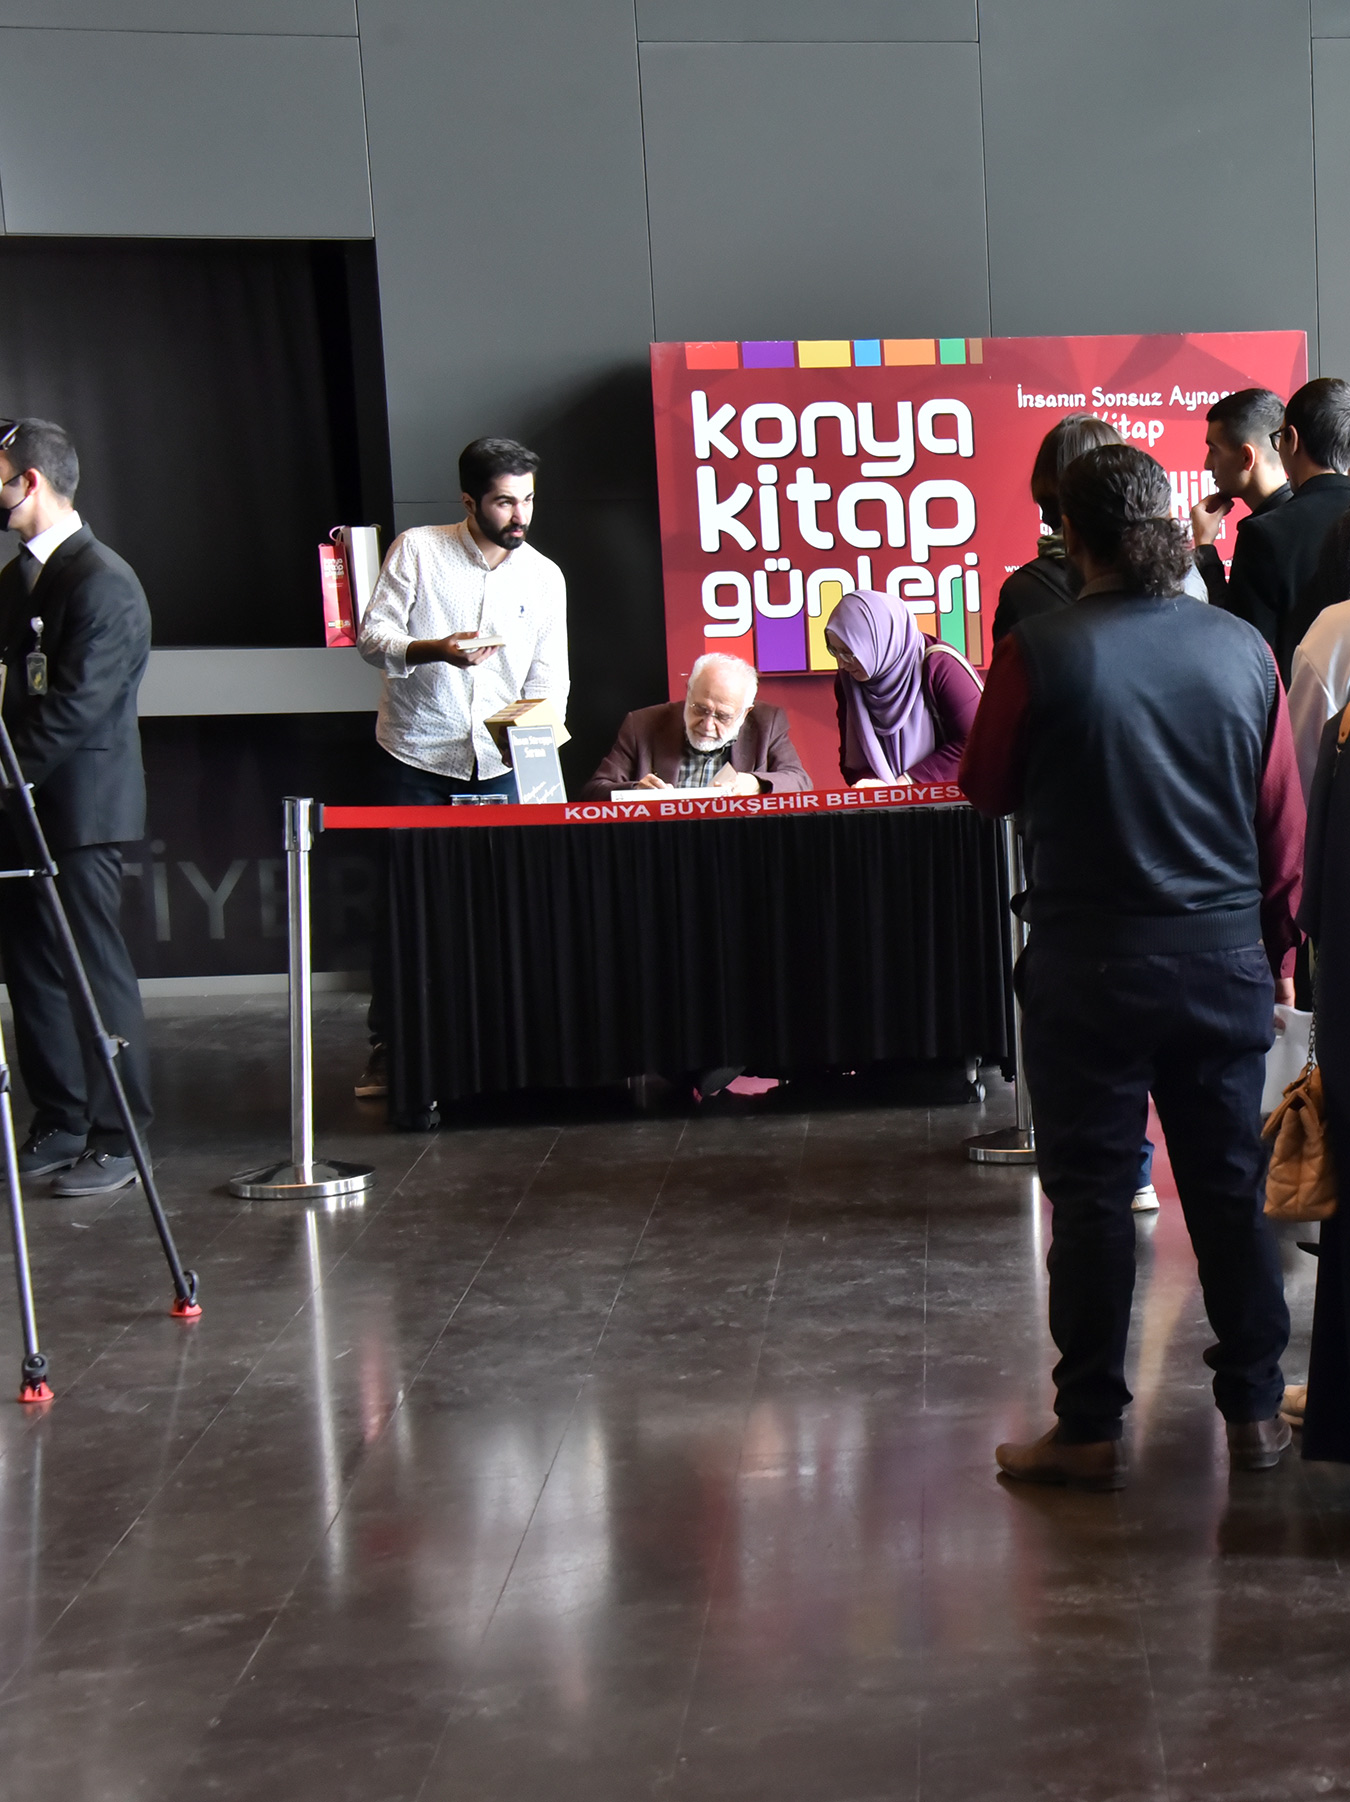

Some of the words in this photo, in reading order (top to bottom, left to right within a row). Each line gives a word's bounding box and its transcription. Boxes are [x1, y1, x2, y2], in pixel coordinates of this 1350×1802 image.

[1017, 384, 1087, 409] İnsanın
[1091, 386, 1164, 408] Sonsuz
[1168, 385, 1236, 412] Aynas
[691, 390, 975, 477] konya
[696, 464, 978, 563] kitap
[564, 804, 651, 820] KONYA
[660, 793, 819, 816] BÜYÜKŞEHİR
[827, 784, 966, 806] BELEDİYES
